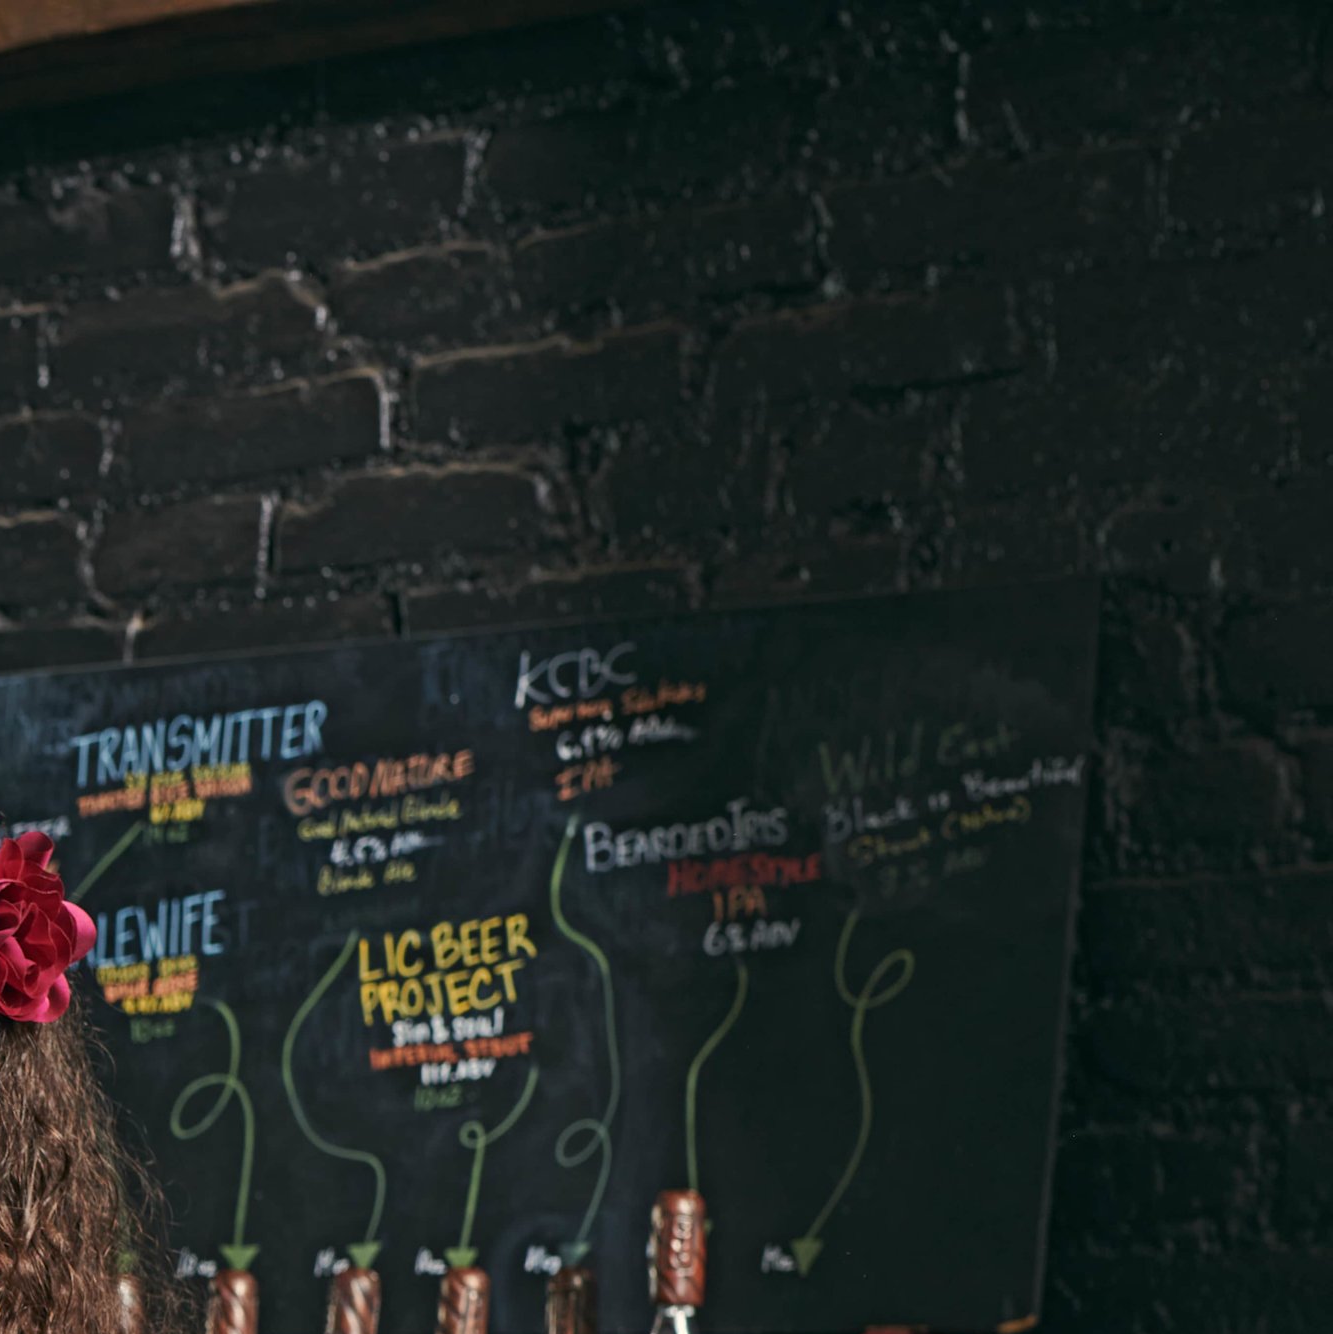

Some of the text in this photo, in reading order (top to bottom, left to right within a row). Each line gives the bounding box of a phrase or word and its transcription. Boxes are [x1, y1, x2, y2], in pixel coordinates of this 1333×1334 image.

[515, 641, 638, 710] KCBC
[69, 700, 328, 788] TRANSMITTER
[283, 761, 370, 817] GOOD
[369, 748, 475, 799] NATURE
[359, 912, 538, 983] LIC BEER
[360, 958, 526, 1027] PROJECT
